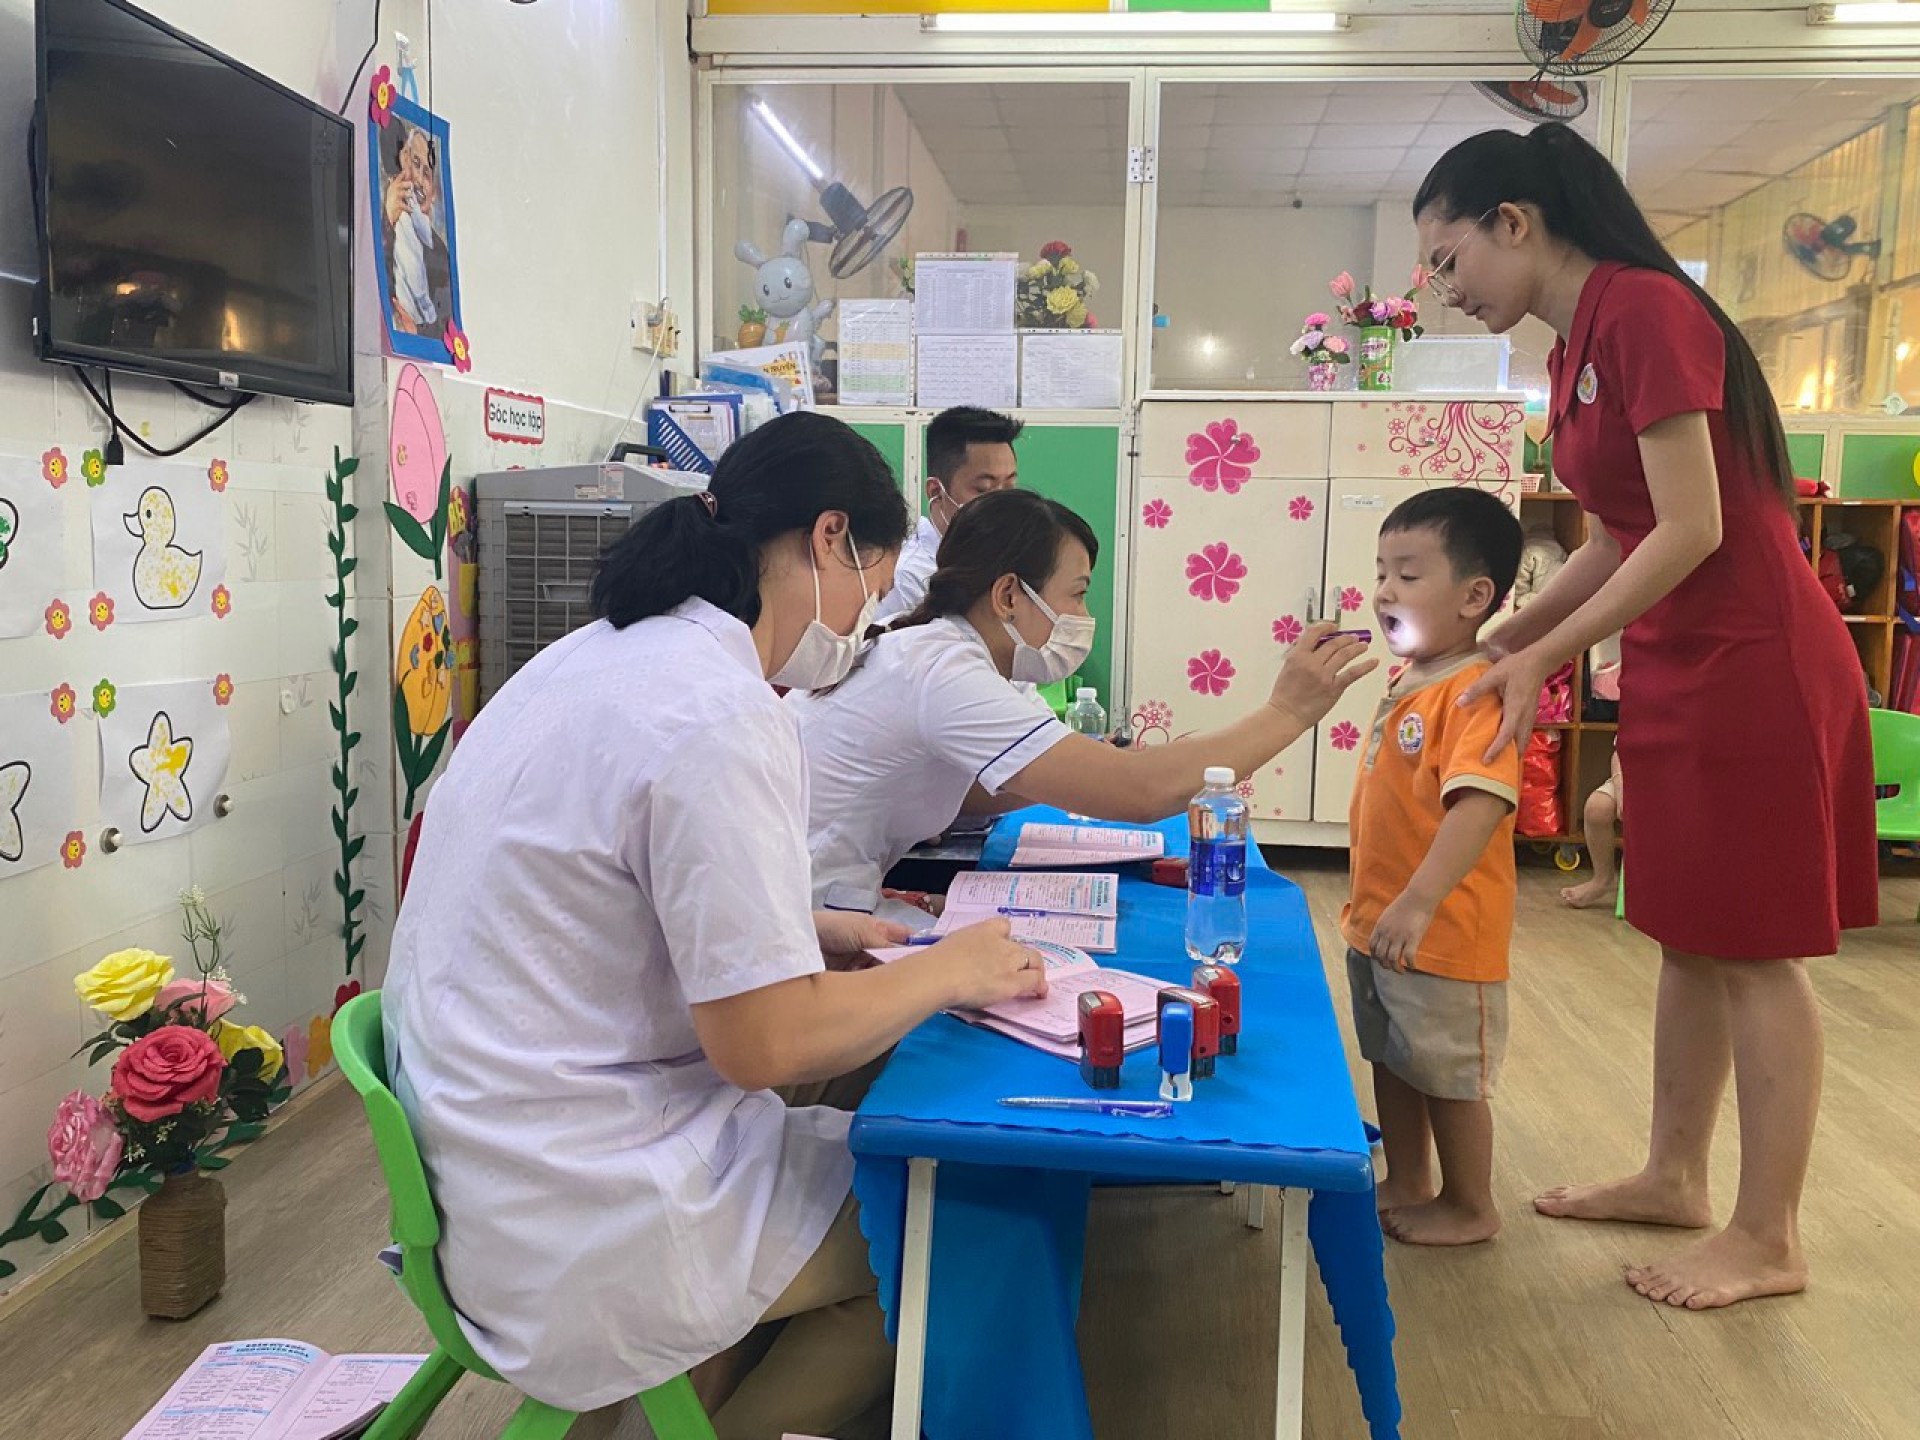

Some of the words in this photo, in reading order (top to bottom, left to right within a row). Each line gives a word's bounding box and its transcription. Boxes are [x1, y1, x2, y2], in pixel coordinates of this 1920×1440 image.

[489, 402, 508, 424] Góc
[509, 405, 526, 430] học
[528, 410, 542, 433] tập
